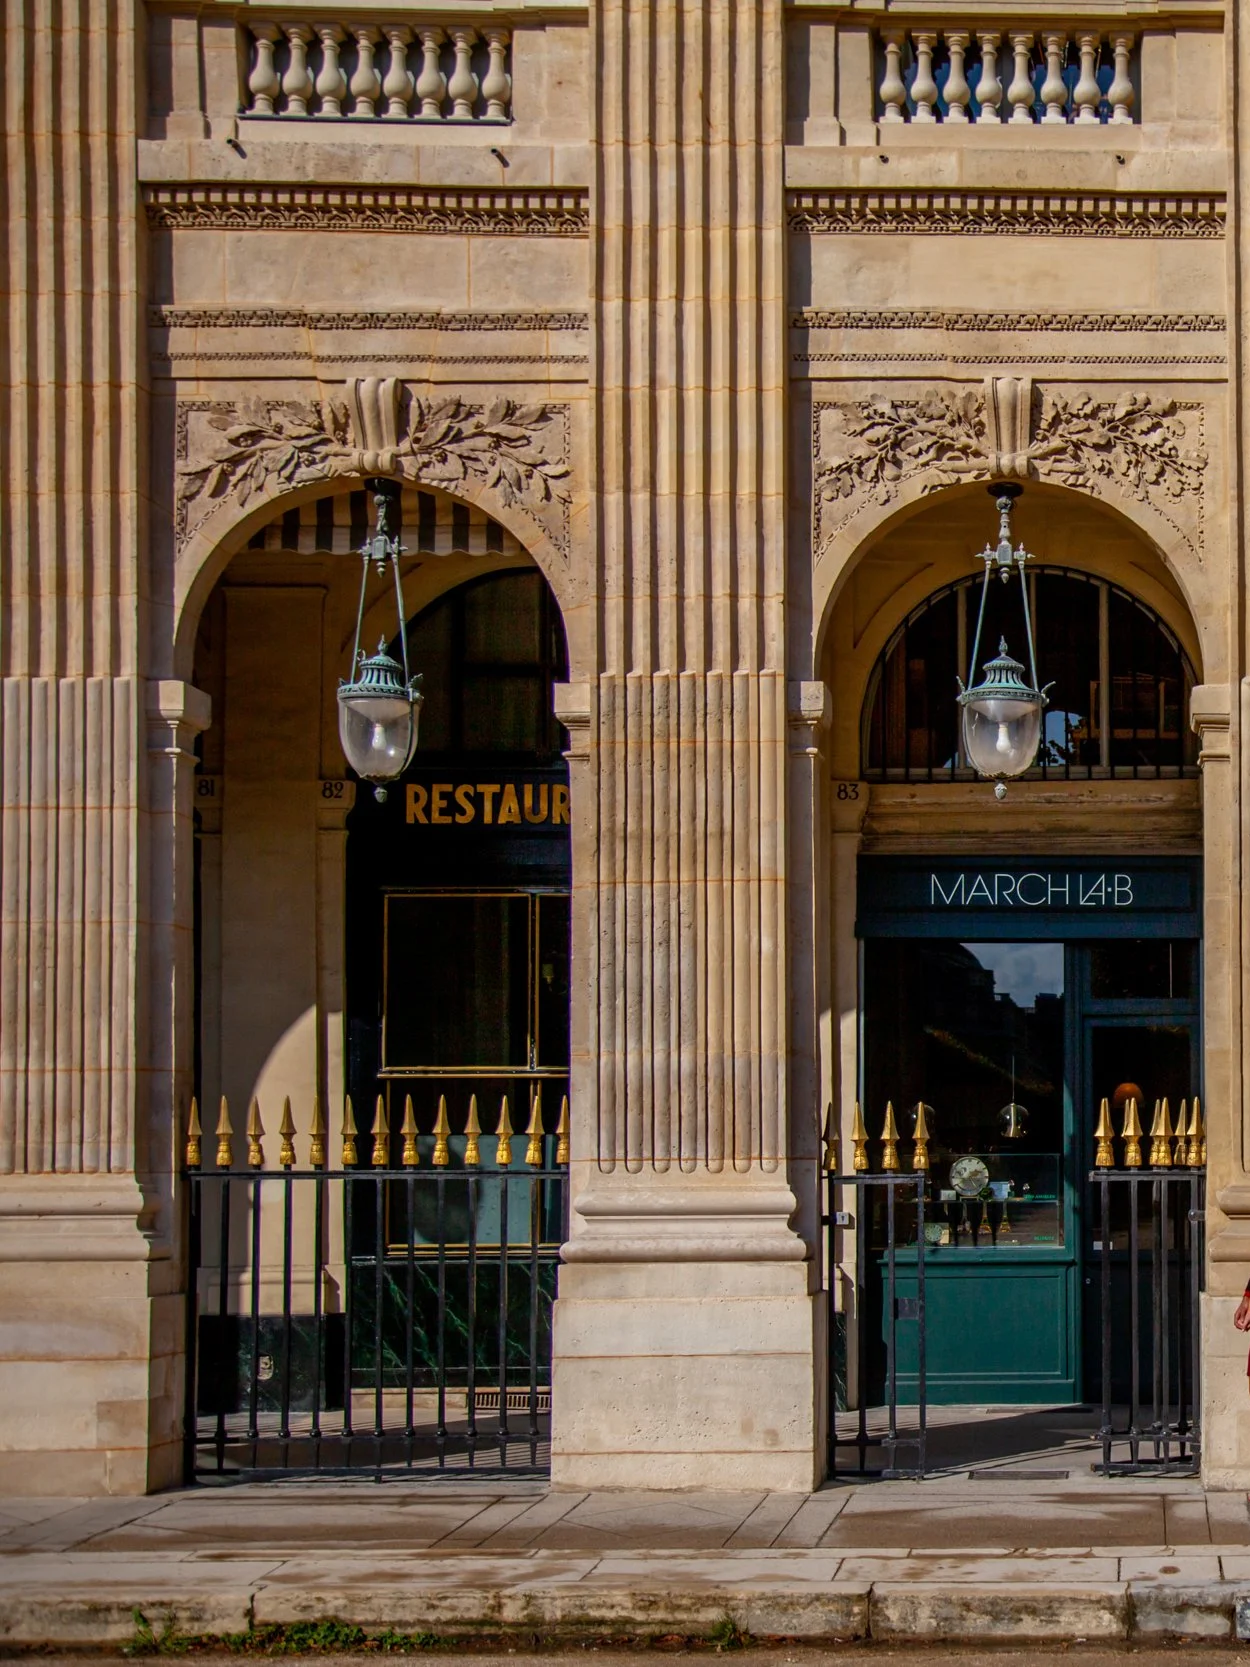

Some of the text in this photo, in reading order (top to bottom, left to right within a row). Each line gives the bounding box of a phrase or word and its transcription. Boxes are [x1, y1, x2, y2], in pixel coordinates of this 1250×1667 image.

[197, 779, 215, 796] 81
[322, 781, 344, 799] 82
[837, 783, 859, 800] 83
[405, 783, 571, 825] RESTAUR
[931, 873, 1069, 905] MARCH
